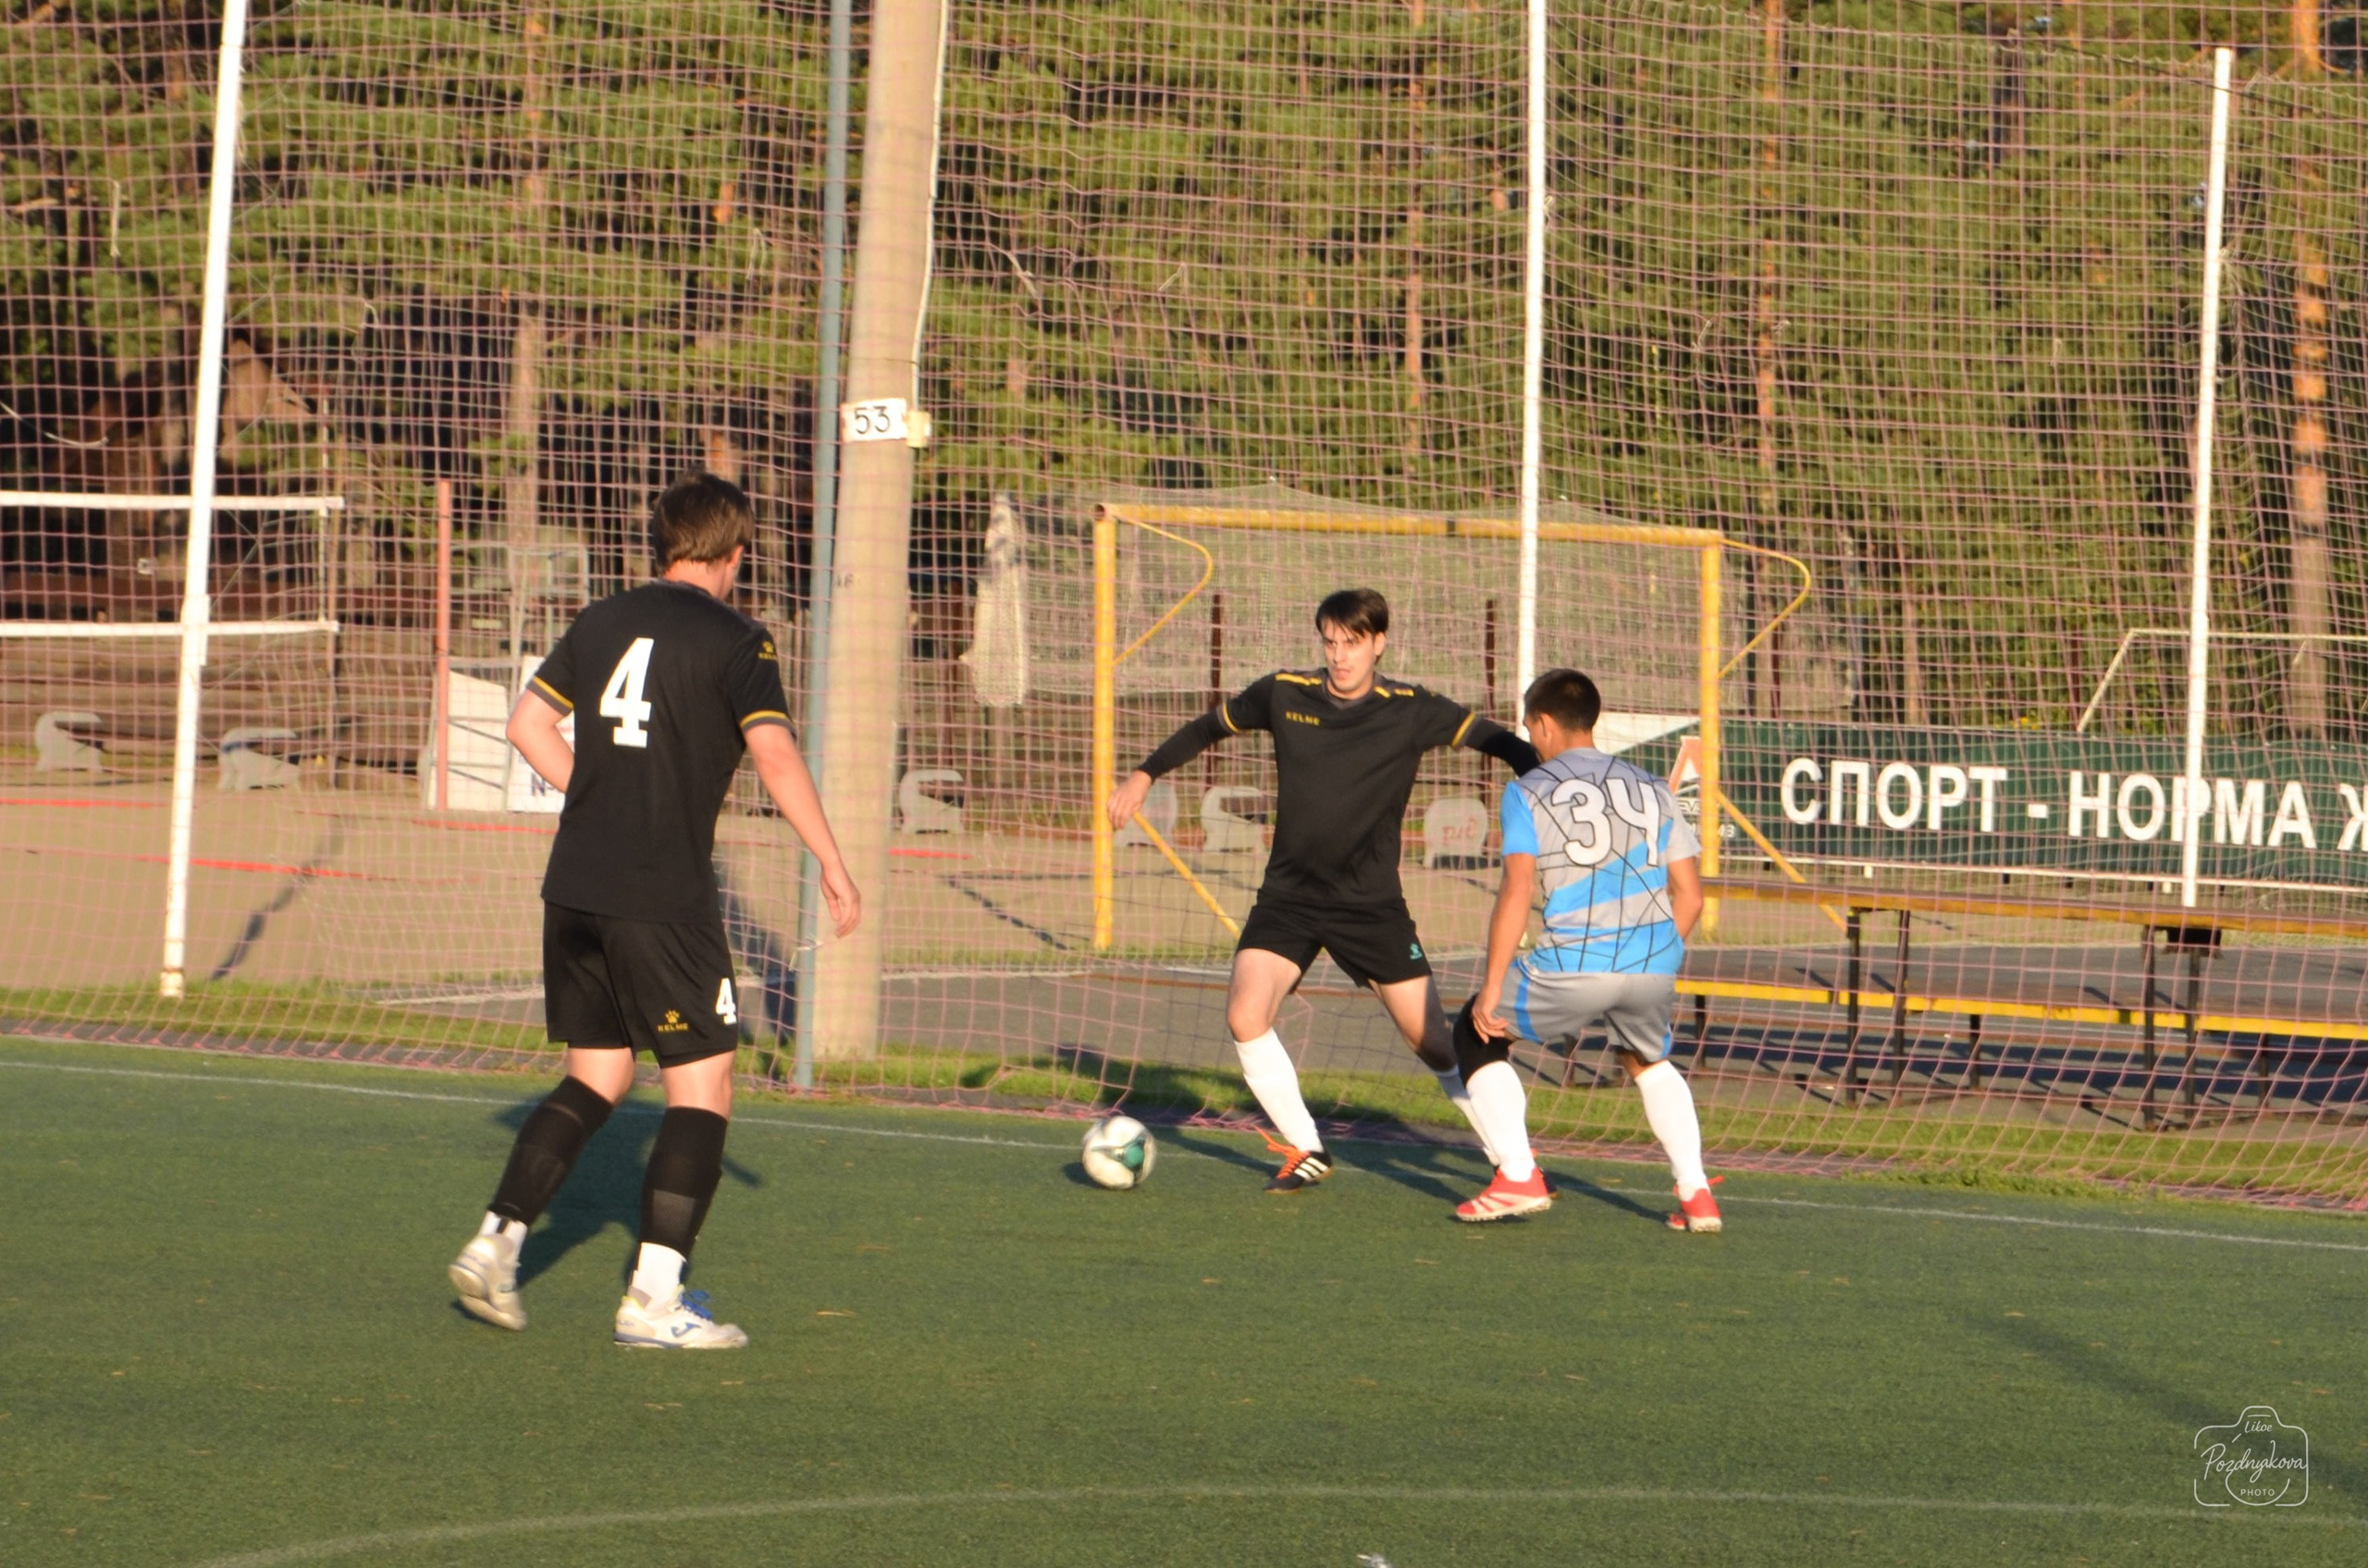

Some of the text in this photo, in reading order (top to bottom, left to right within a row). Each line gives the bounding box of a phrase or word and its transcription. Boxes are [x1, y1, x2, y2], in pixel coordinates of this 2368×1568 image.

[853, 405, 890, 435] 53
[599, 636, 654, 748] 4
[1550, 778, 1660, 867] 34
[1781, 757, 2007, 832] СПОРТ
[2068, 770, 2317, 849] НОРМА
[658, 1022, 688, 1032] KELME
[715, 977, 737, 1025] 4
